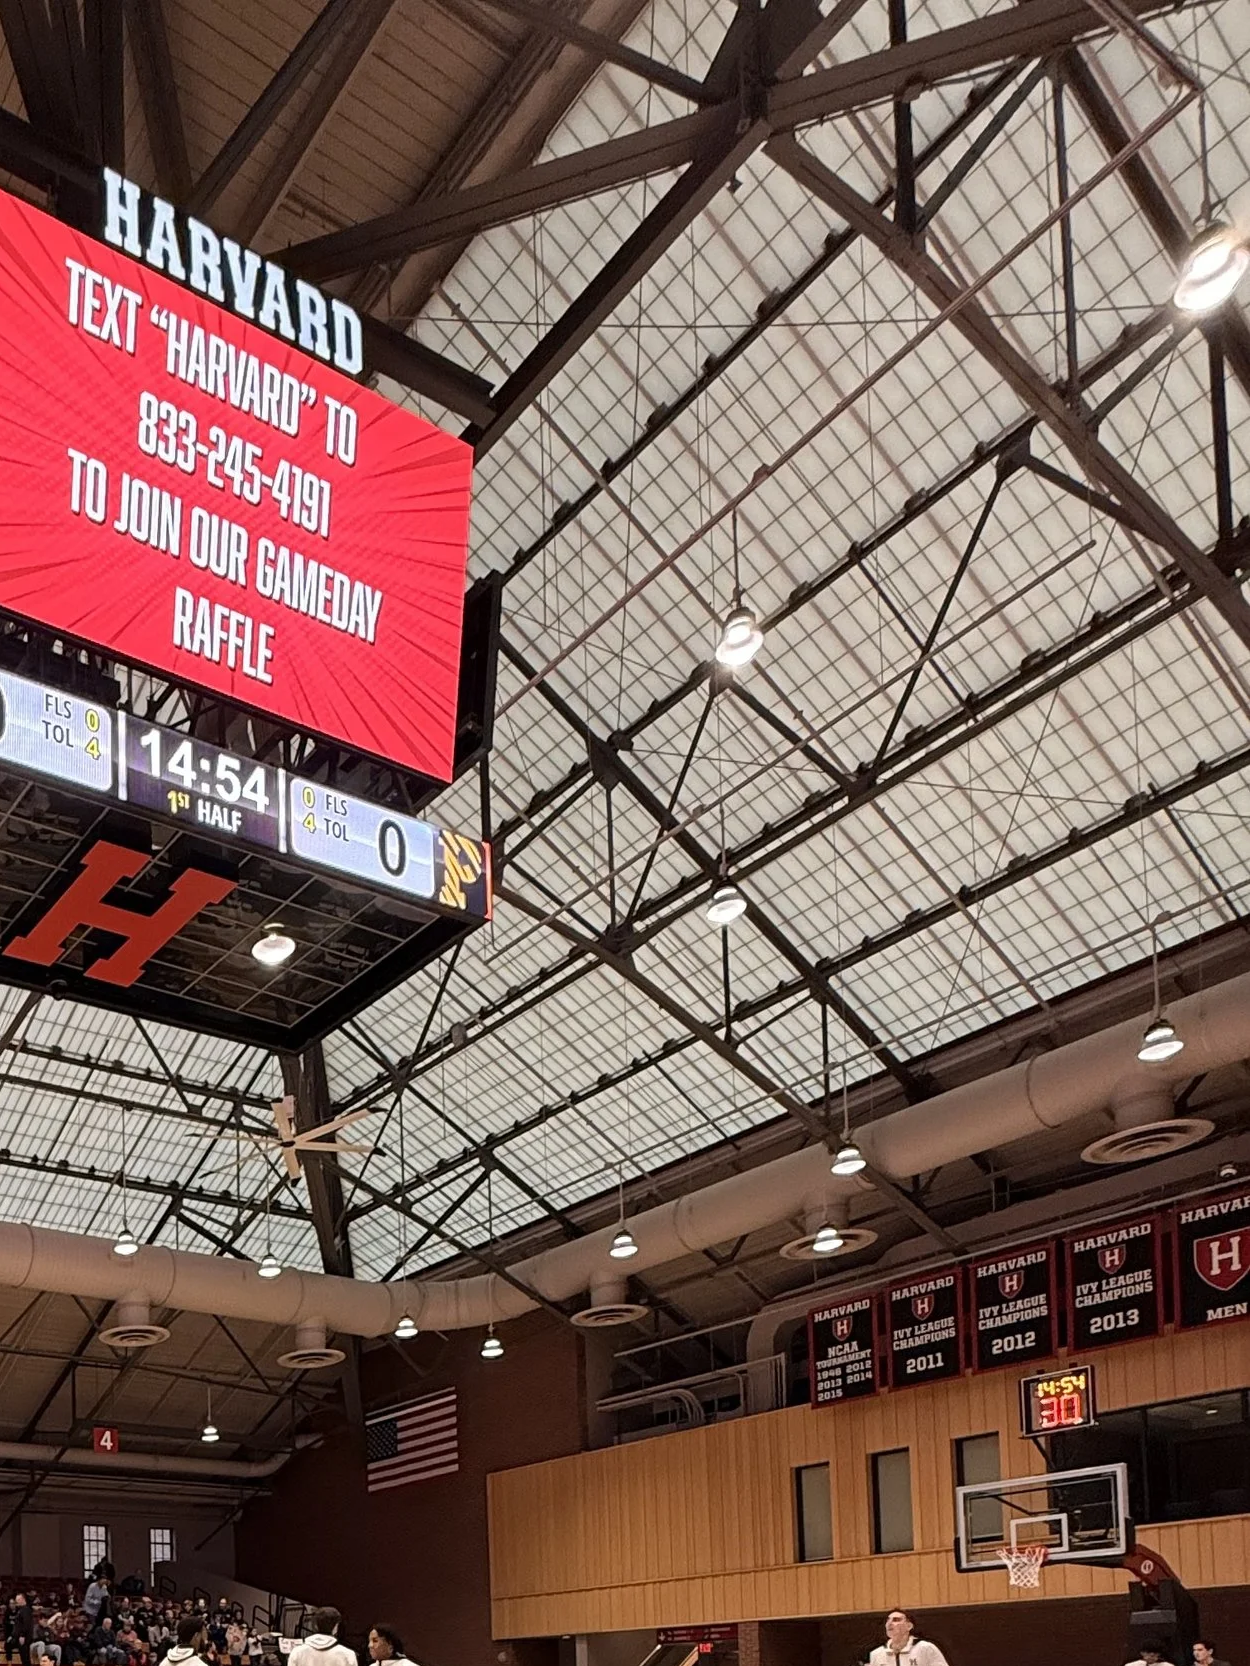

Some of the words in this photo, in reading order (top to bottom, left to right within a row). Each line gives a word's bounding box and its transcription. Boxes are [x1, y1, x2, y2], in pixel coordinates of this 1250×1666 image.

[103, 166, 364, 376] HARVARD
[65, 257, 142, 354] TEXT
[323, 396, 358, 466] TO
[138, 392, 333, 539] 833-245-4191
[67, 448, 107, 523] TO
[113, 468, 181, 557] JOIN
[188, 495, 251, 584] OUR
[254, 525, 384, 643] GAMEDAY
[172, 585, 275, 685] RAFFLE
[44, 693, 72, 720] FLS
[84, 708, 101, 733] 0
[41, 719, 74, 749] TOL
[84, 736, 102, 760] 4
[139, 728, 270, 814] 14:54
[301, 786, 316, 809] 0
[325, 795, 348, 817] FLS
[197, 799, 242, 835] HALF
[301, 813, 317, 834] 4
[323, 817, 350, 842] TOL
[377, 818, 408, 877] 0
[2, 839, 239, 988] H
[1074, 1222, 1152, 1254] HARVARD
[977, 1250, 1047, 1279] HARVARD
[1104, 1249, 1120, 1268] H
[1209, 1235, 1242, 1276] H
[891, 1275, 954, 1302] HARVARD
[1003, 1274, 1019, 1293] H
[1075, 1280, 1154, 1309] CHAMPIONS
[1076, 1281, 1099, 1296] IVY
[1102, 1268, 1152, 1292] LEAGUE
[813, 1299, 871, 1323] HARVARD
[916, 1297, 930, 1316] H
[978, 1308, 1000, 1320] IVY
[1002, 1294, 1047, 1316] LEAGUE
[978, 1305, 1048, 1331] CHAMPIONS
[836, 1319, 848, 1337] H
[893, 1329, 911, 1341] IVY
[914, 1316, 955, 1338] LEAGUE
[1089, 1308, 1140, 1335] 2013
[827, 1340, 859, 1359] NCAA
[893, 1328, 956, 1352] CHAMPIONS
[991, 1331, 1037, 1356] 2012
[816, 1349, 872, 1370] TOURNAMENT
[845, 1360, 873, 1374] 2012
[906, 1351, 945, 1375] 2011
[817, 1378, 843, 1391] 2013
[846, 1371, 873, 1385] 2014
[817, 1388, 843, 1401] 2015
[1036, 1372, 1086, 1398] 14:54
[1040, 1394, 1083, 1429] 30
[99, 1430, 114, 1450] 4
